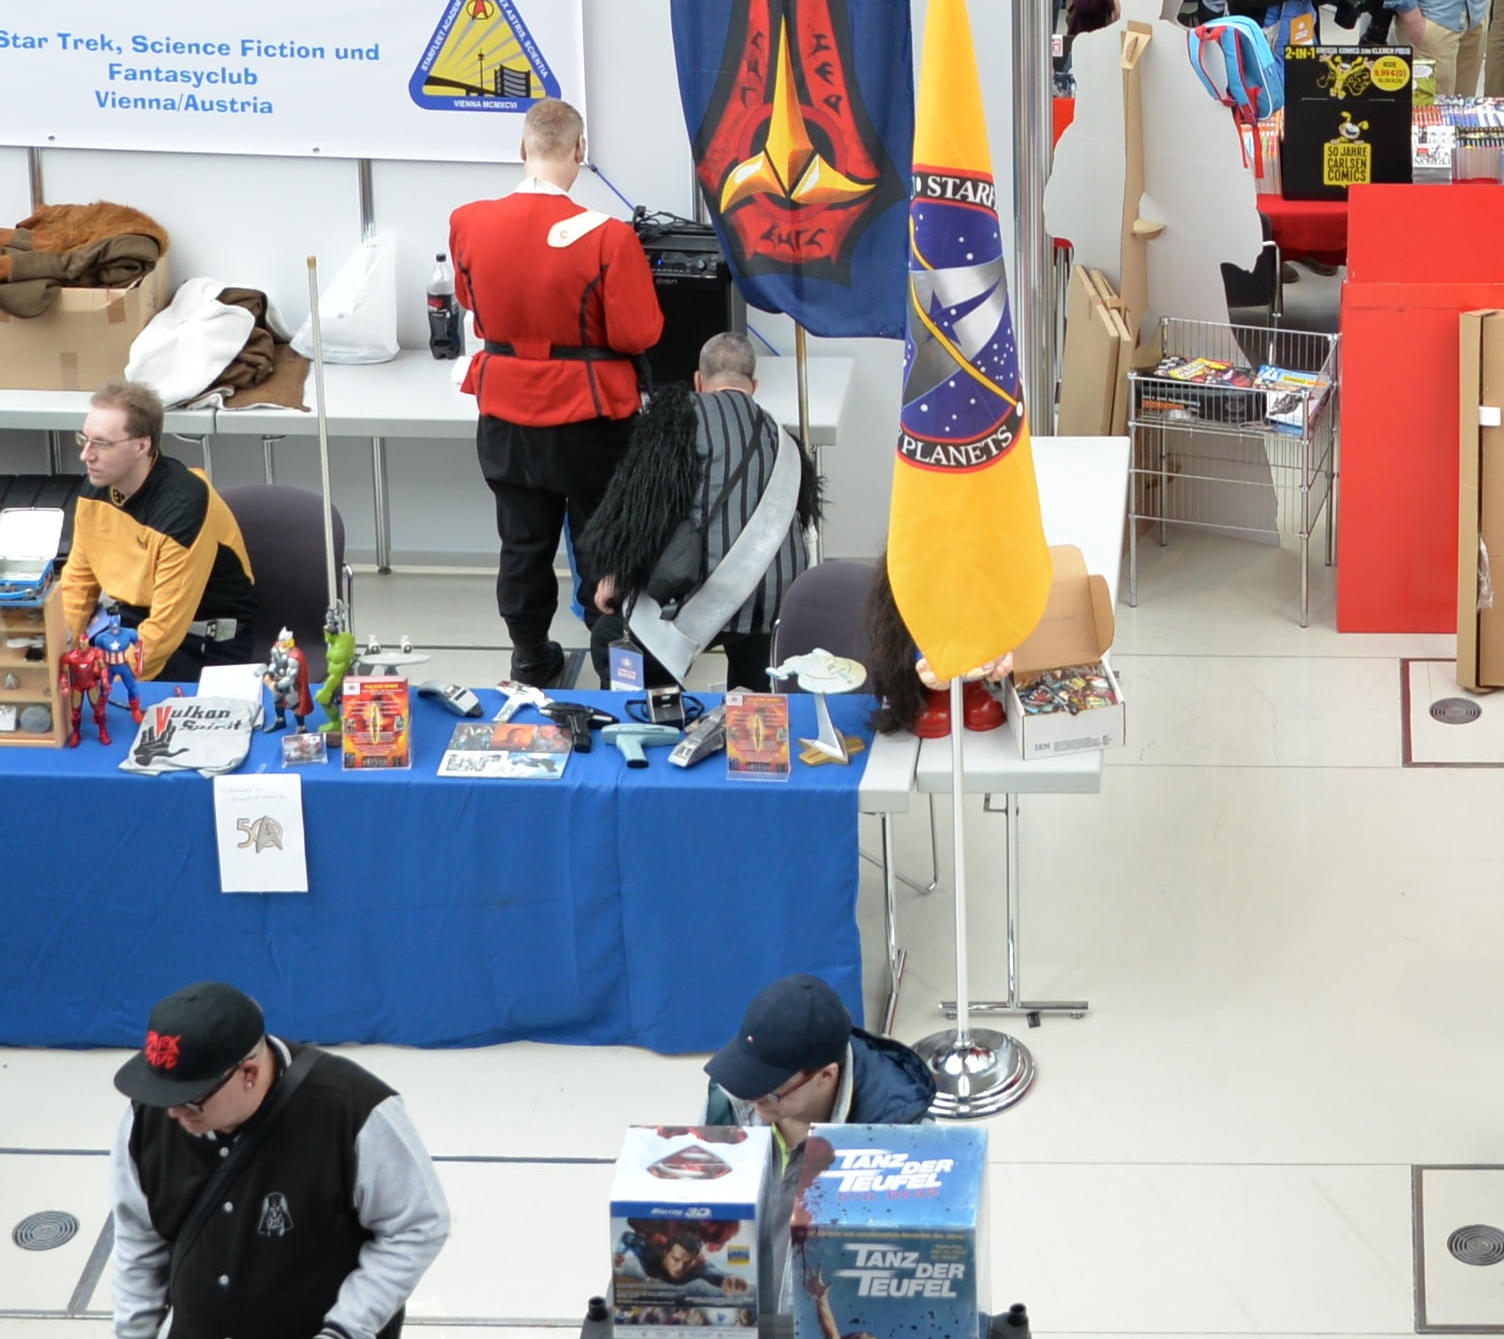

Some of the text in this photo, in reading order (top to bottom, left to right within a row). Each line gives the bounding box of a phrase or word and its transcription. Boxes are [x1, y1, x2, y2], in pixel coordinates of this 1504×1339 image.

[56, 32, 123, 56] Trek,
[131, 35, 232, 57] Science
[240, 39, 325, 61] Fiction
[334, 43, 381, 62] und
[420, 27, 449, 73] STARFLEET
[524, 39, 549, 80] SCIENTIA
[1285, 46, 1316, 60] 2-IN-1
[108, 62, 258, 89] Fantasyclub
[95, 89, 273, 115] Vienna/Austria
[453, 99, 482, 109] VIENNA
[1326, 157, 1367, 170] CARLSEN
[1327, 146, 1367, 157] 50 JAHRE
[1327, 169, 1367, 182] COMICS
[901, 425, 1013, 467] PLANETS
[155, 705, 231, 738] Vulkan
[178, 718, 242, 734] Spirit
[833, 1148, 954, 1177] TANZ DER
[819, 1170, 943, 1193] TEUFEL
[685, 1207, 712, 1219] 3D
[842, 1243, 965, 1280] TANZ DER
[832, 1269, 957, 1298] TEUFEL
